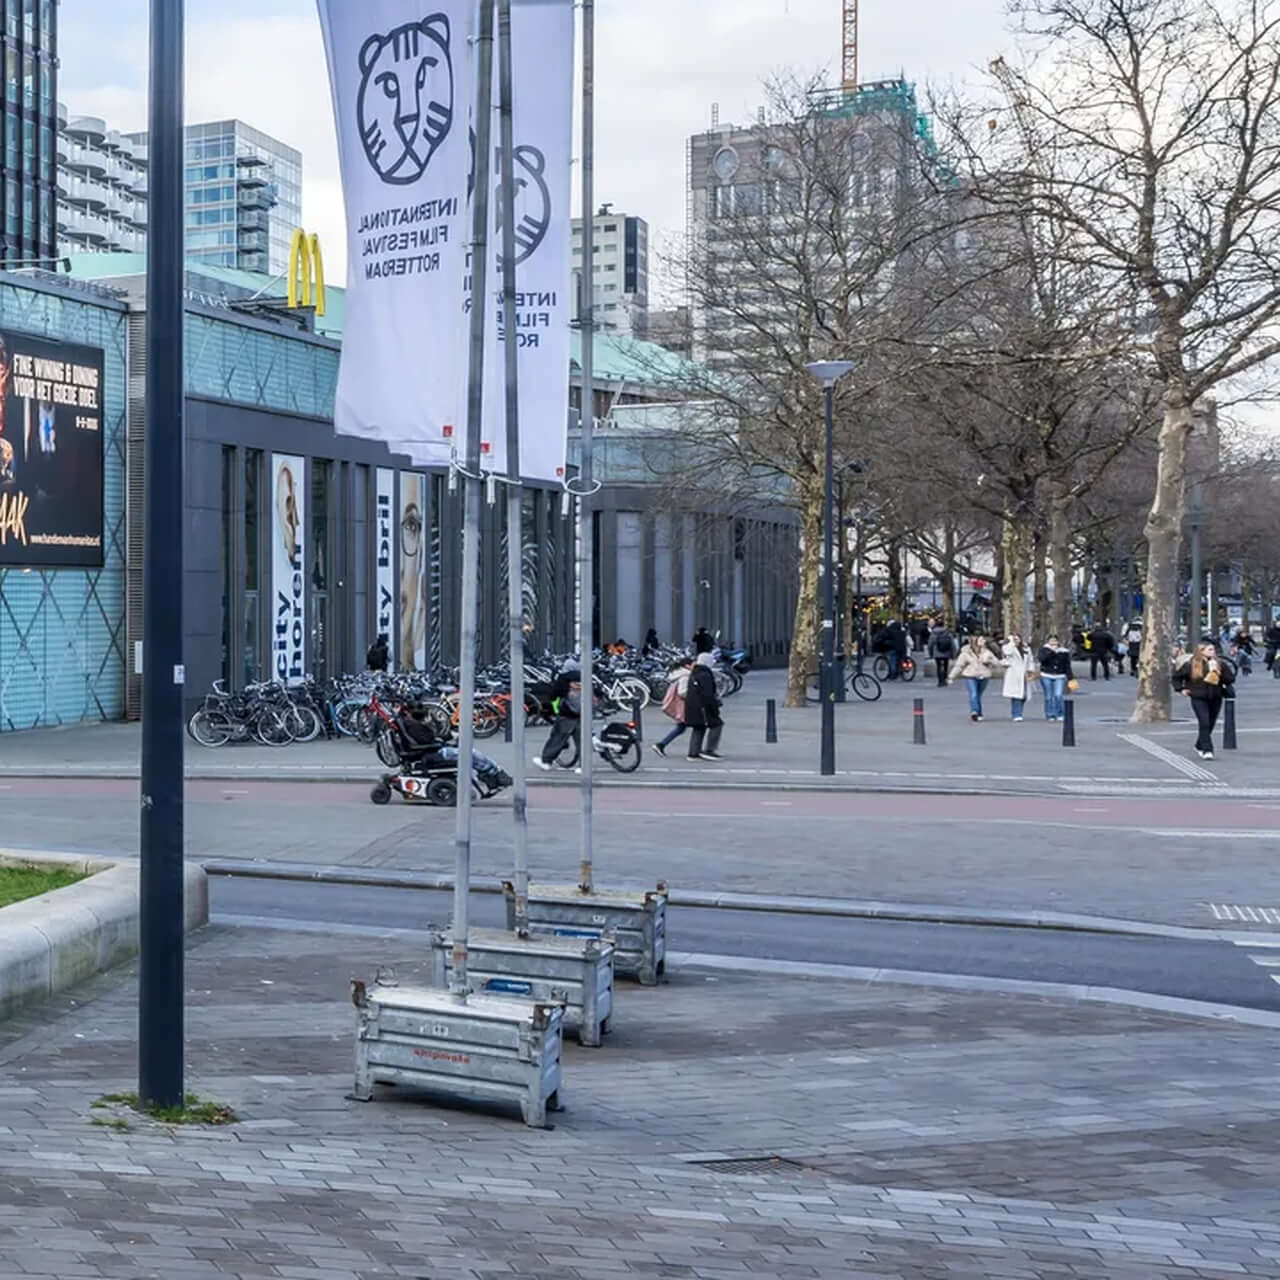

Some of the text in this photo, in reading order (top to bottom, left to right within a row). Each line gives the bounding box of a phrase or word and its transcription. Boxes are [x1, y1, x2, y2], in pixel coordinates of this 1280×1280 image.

[13, 353, 33, 376] FINE
[13, 376, 35, 399] VOOR
[36, 380, 52, 402] HET
[53, 383, 78, 406] GOEDE
[378, 495, 390, 567] bril
[274, 591, 291, 680] city
[289, 544, 302, 677] horen
